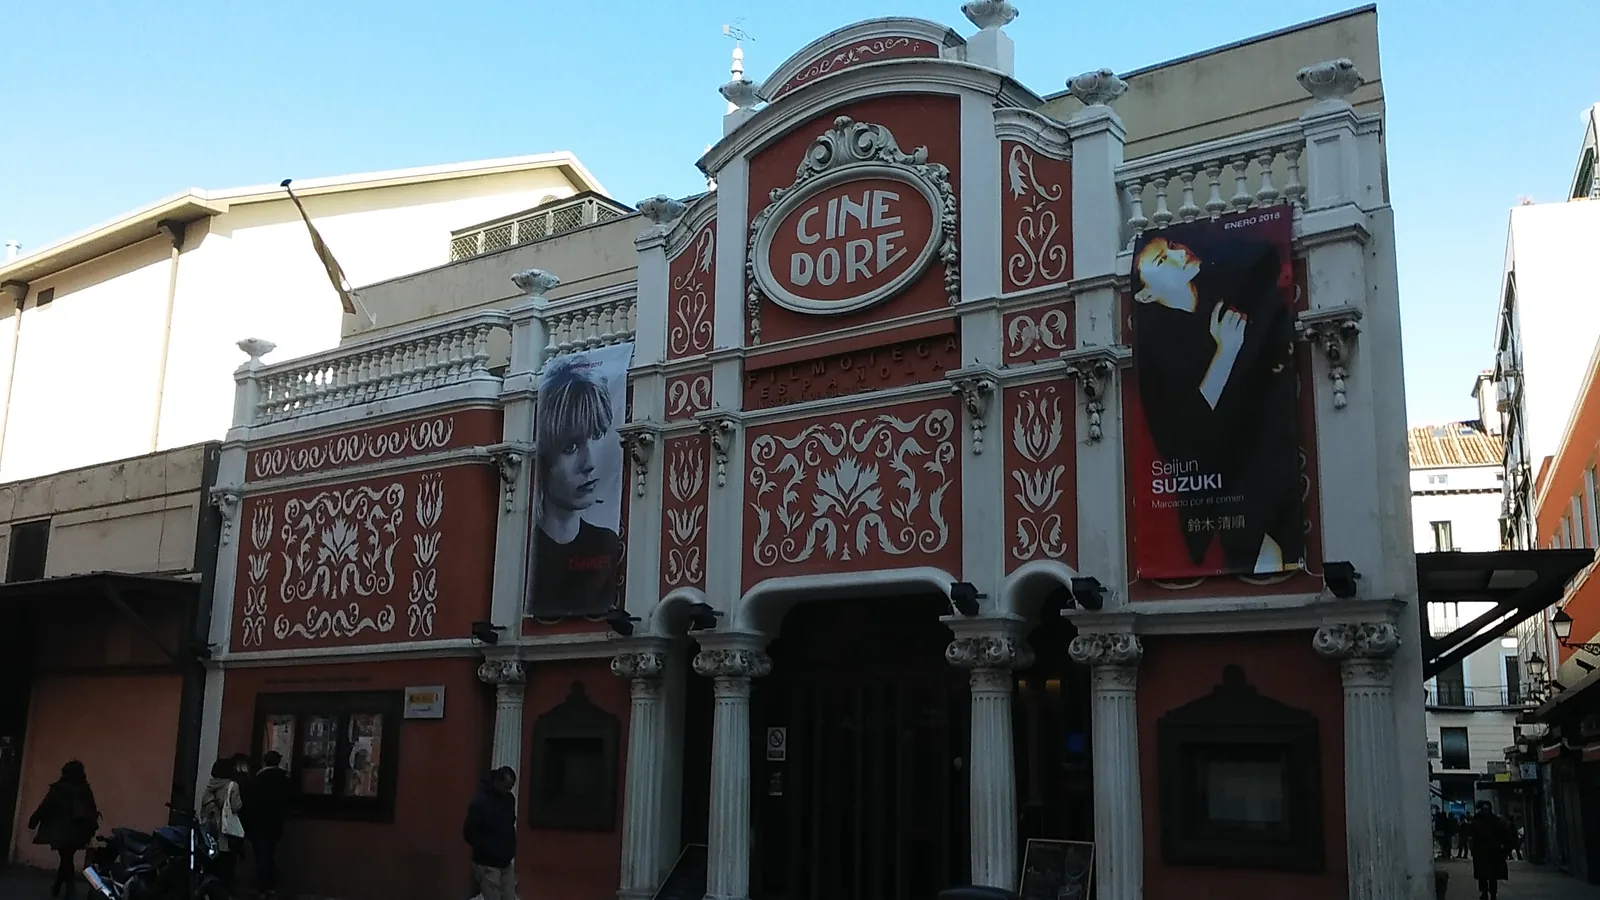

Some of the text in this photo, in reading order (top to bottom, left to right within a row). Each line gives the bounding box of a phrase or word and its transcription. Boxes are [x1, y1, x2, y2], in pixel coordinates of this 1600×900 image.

[796, 190, 901, 245] CINE
[1224, 212, 1280, 230] ENERO 2018
[790, 230, 908, 286] DORE
[747, 336, 957, 389] FILMOTECA
[760, 359, 943, 398] ESPAÑOLA
[1151, 458, 1198, 477] Seijun
[1151, 473, 1223, 494] SUZUKI
[1151, 499, 1189, 509] Marcado
[1190, 498, 1204, 507] por
[1206, 496, 1214, 504] el
